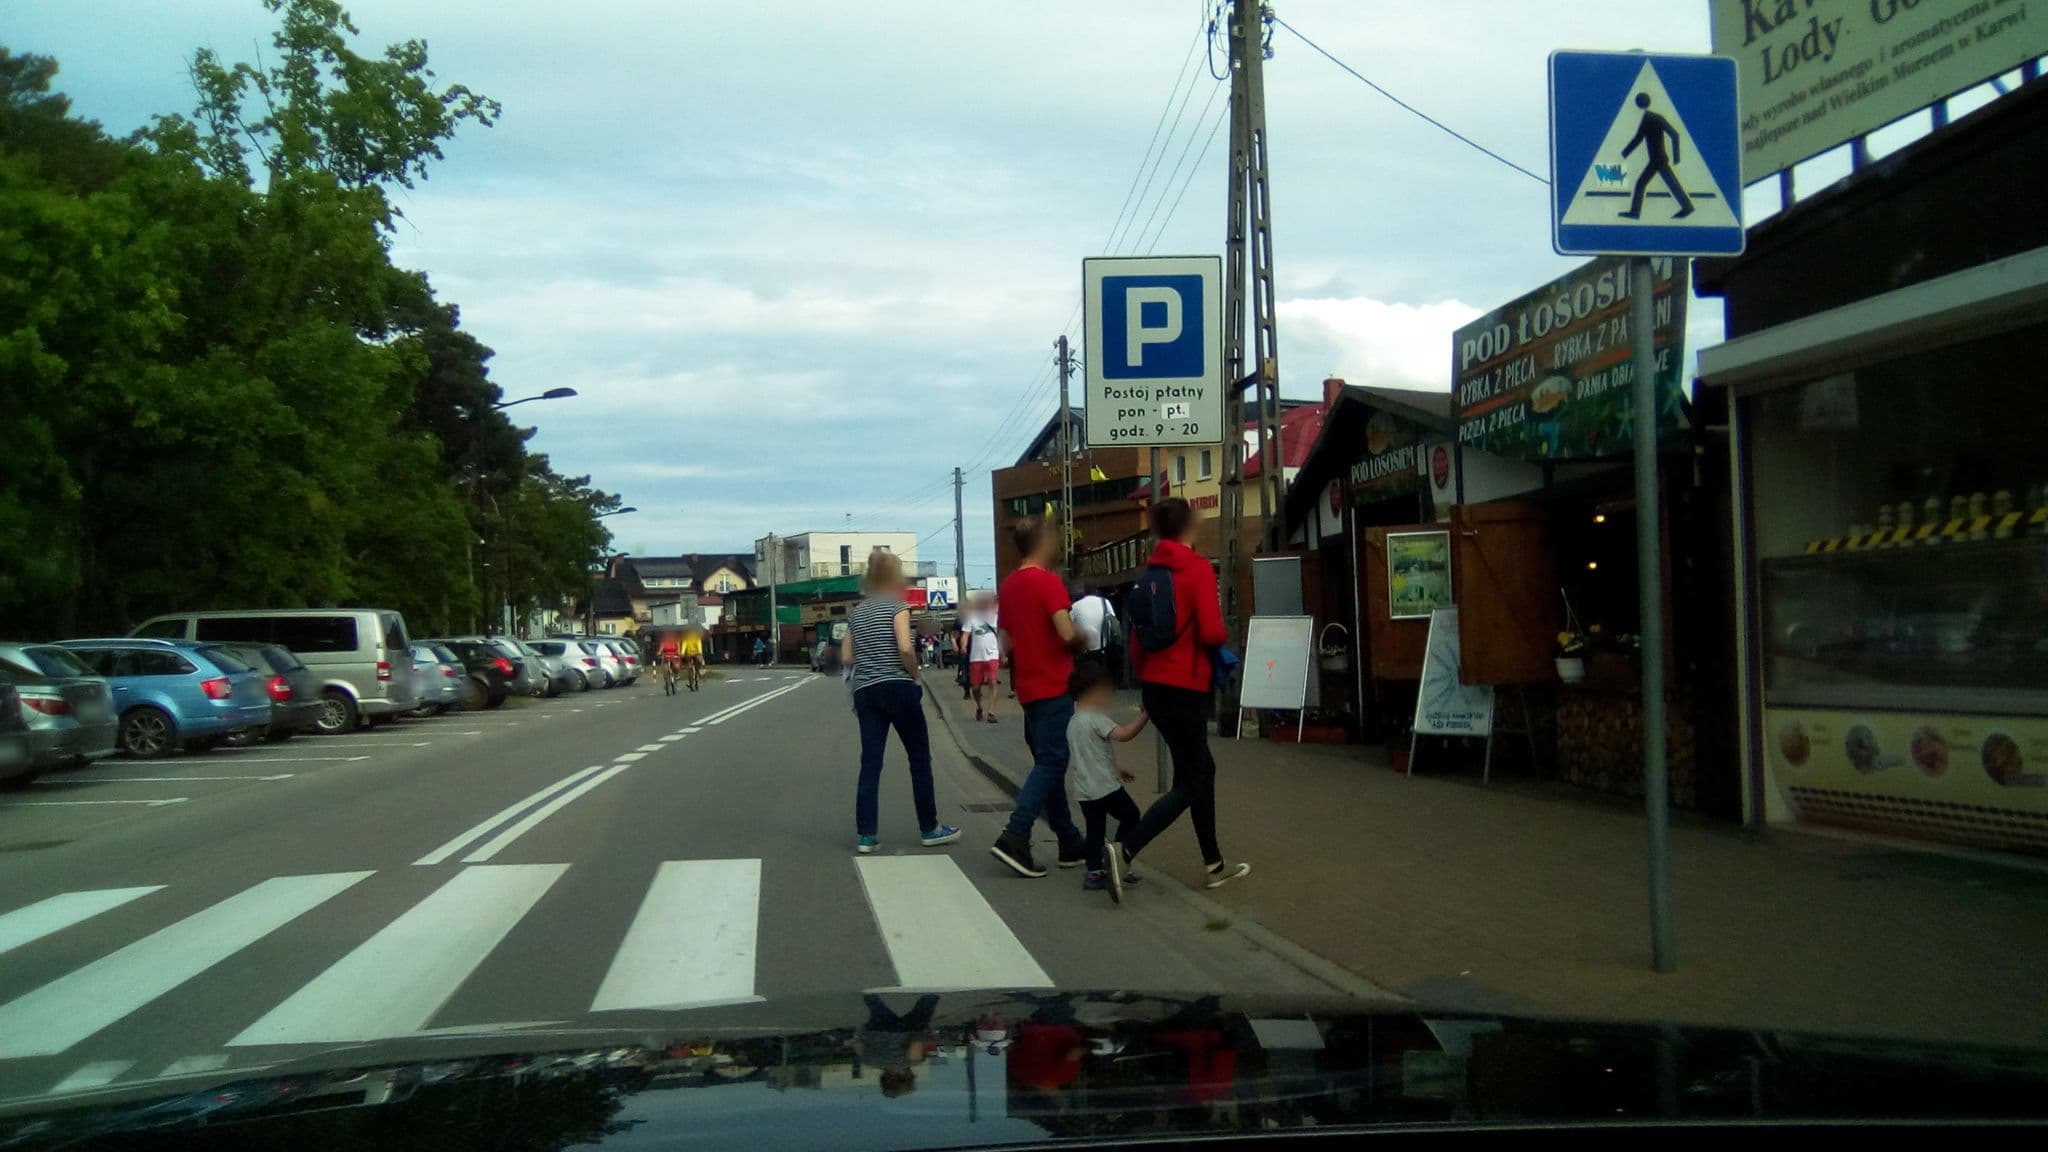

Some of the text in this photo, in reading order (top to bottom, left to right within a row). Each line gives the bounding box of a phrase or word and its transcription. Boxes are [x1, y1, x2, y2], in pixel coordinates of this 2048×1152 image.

[1802, 100, 1827, 125] nad
[1974, 2, 2027, 43] Karwi
[1126, 287, 1183, 367] P
[1461, 322, 1511, 371] POD
[1554, 329, 1592, 370] RYBKA
[1596, 320, 1608, 353] Z
[1104, 385, 1204, 401] Postój płatny
[1460, 353, 1537, 408] RYBKA Z PIECA
[1576, 370, 1609, 401] DANIA
[1110, 425, 1149, 441] godz.
[1155, 424, 1164, 436] 9
[1182, 423, 1199, 436] 20
[1118, 408, 1146, 421] pon
[1167, 403, 1186, 419] pt.
[1458, 402, 1526, 443] PIZZA Z PIECA
